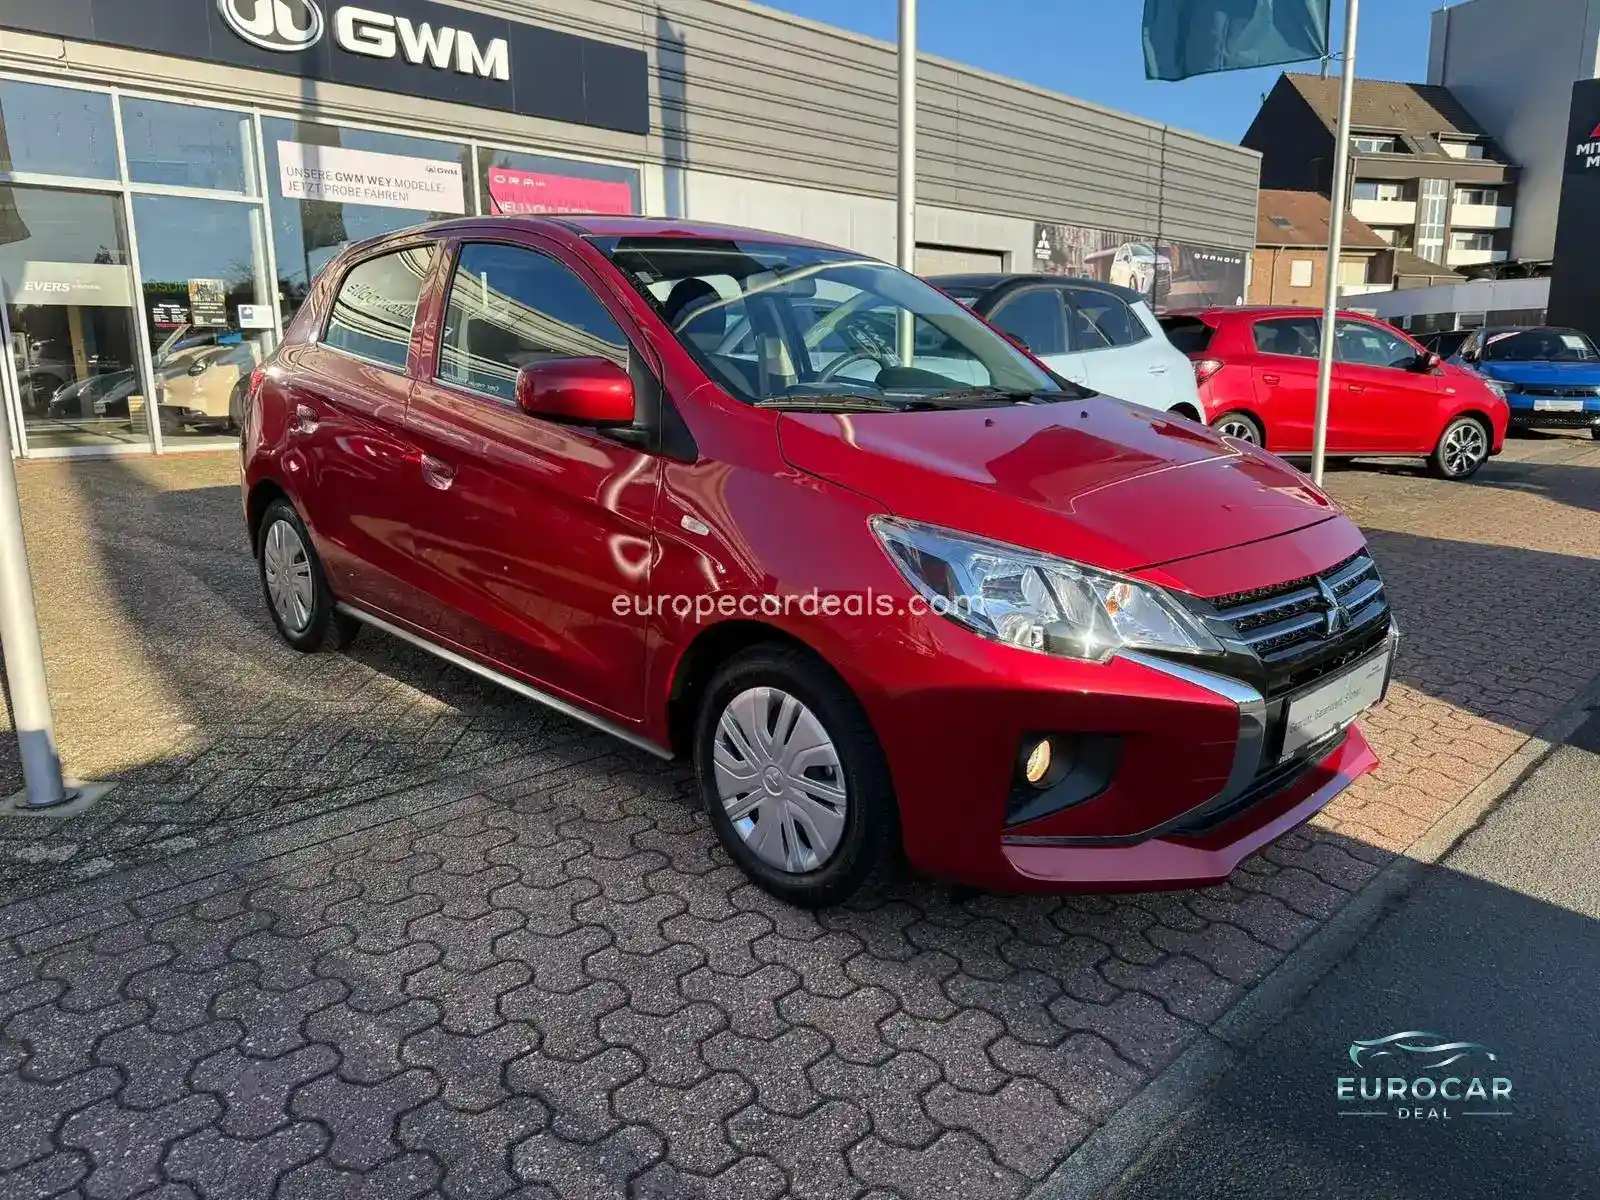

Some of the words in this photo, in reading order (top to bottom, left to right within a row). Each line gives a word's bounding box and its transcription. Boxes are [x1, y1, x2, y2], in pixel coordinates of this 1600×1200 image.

[333, 5, 510, 81] GWM
[286, 166, 333, 181] UNSERE
[335, 171, 364, 185] GWM
[366, 175, 391, 187] WEY
[288, 180, 322, 194] JETZT
[323, 183, 361, 197] PROBE
[363, 187, 409, 202] FAHREN!
[24, 280, 71, 292] EVERS
